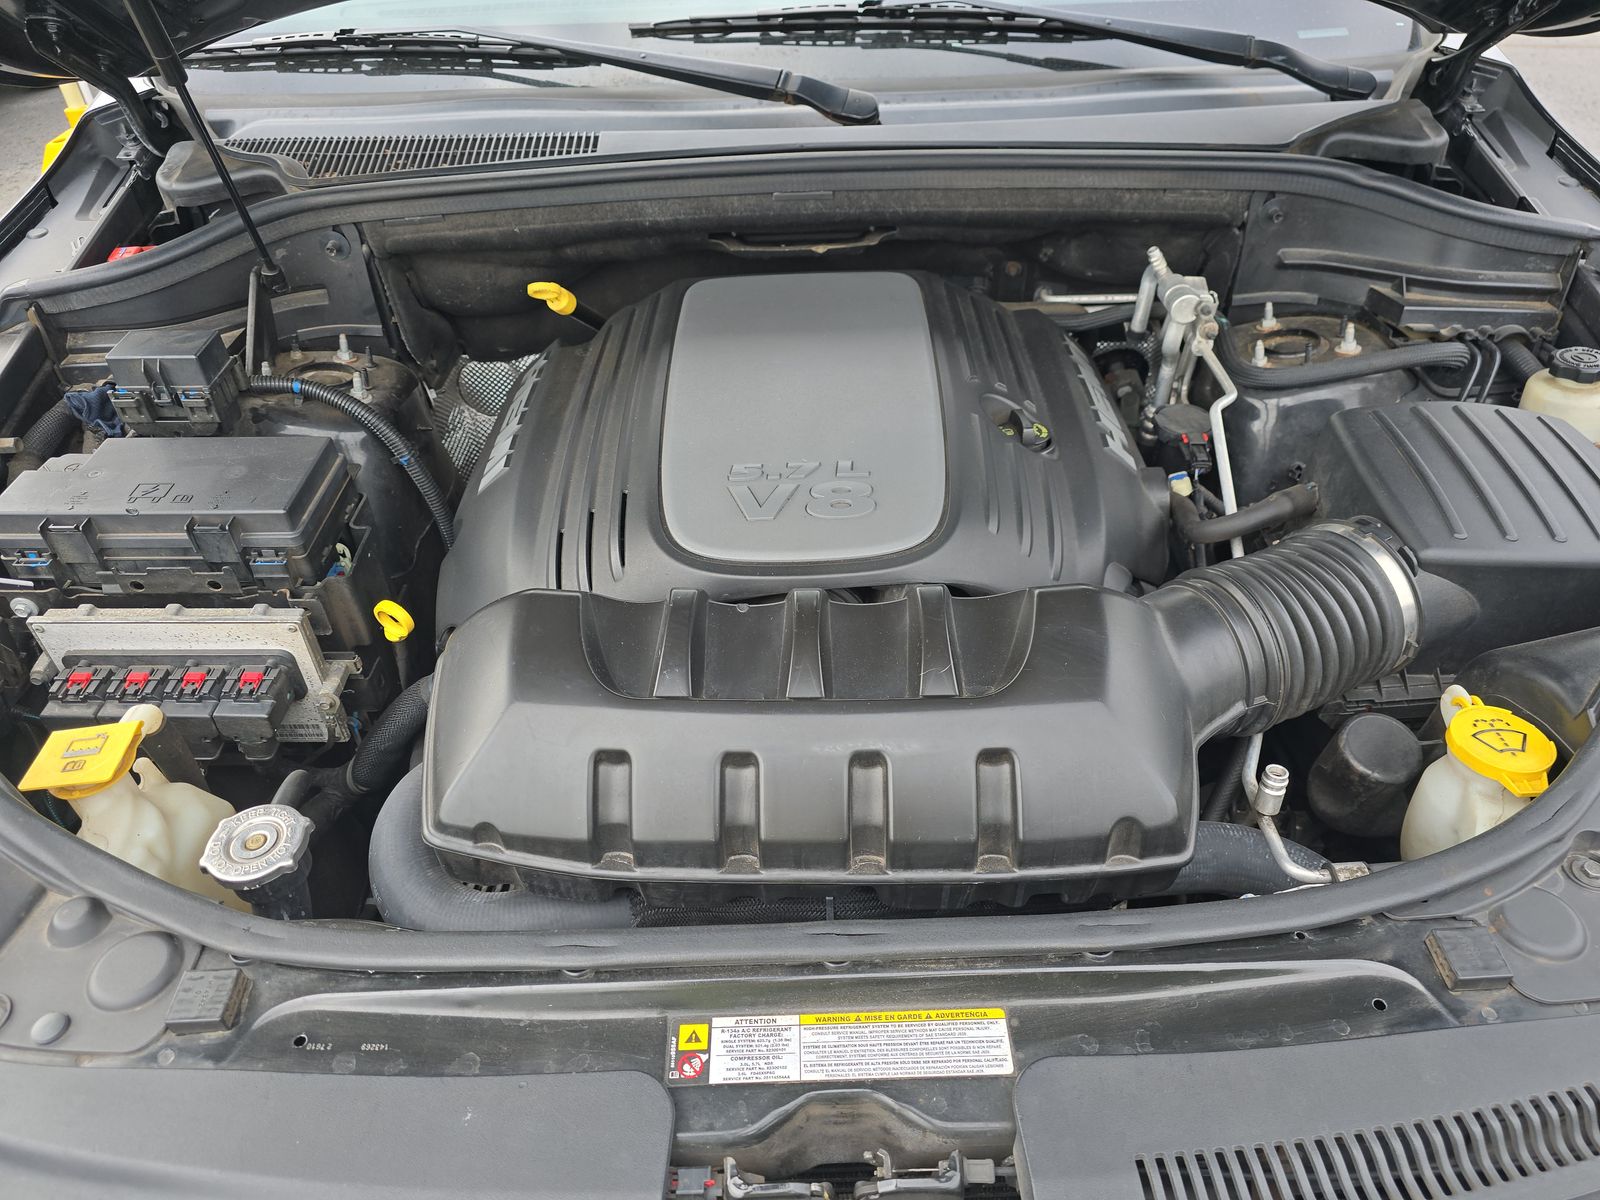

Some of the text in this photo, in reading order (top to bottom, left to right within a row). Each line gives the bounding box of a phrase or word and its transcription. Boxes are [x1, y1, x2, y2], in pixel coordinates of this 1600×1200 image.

[727, 480, 877, 521] V8
[231, 808, 264, 827] KEEP
[234, 861, 268, 874] OPEN
[360, 1043, 389, 1051] 143269
